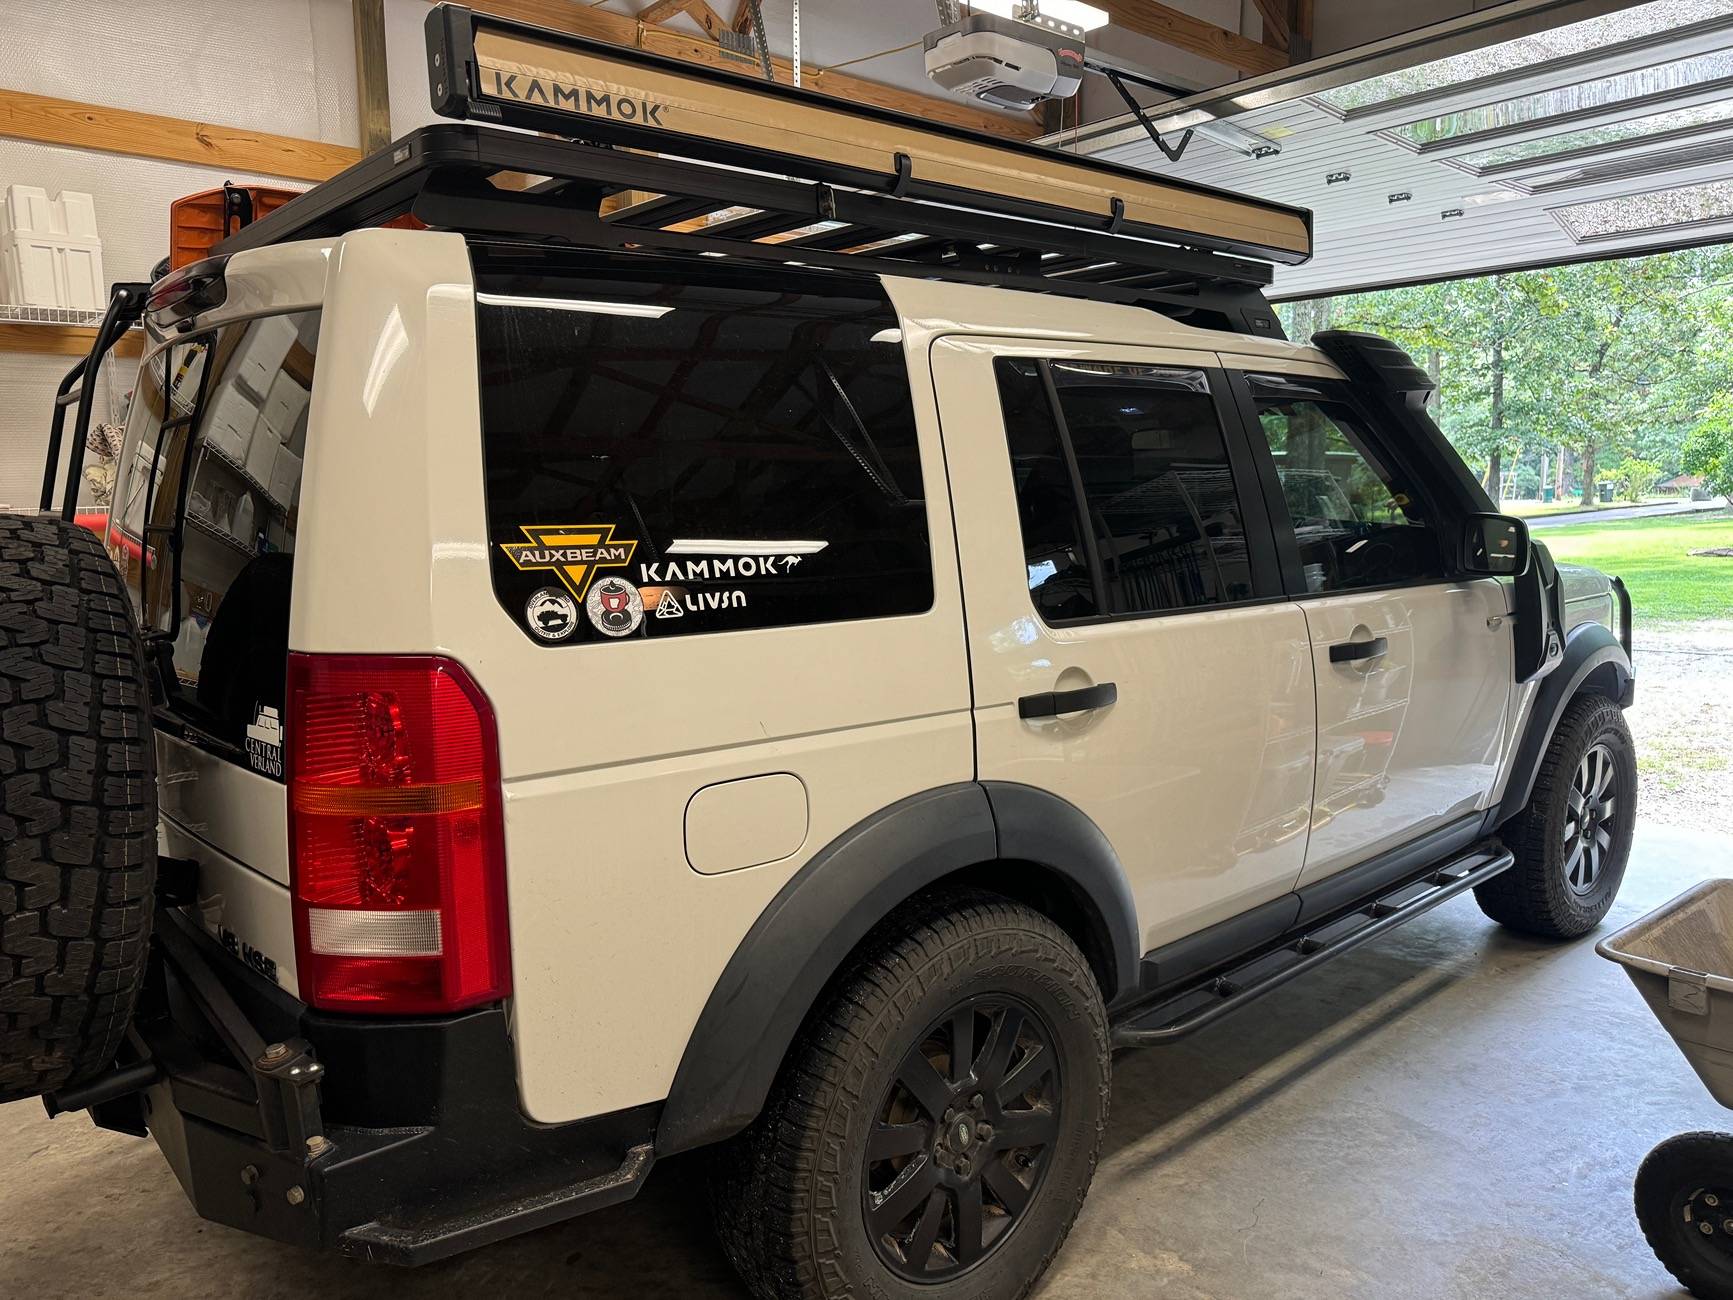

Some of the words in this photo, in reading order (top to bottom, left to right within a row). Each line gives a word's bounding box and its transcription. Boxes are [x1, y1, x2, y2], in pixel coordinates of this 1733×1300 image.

[495, 72, 664, 126] KAMMOK
[519, 548, 626, 563] AUXBEAM
[640, 556, 778, 582] KAMMOK
[245, 737, 282, 763] CENTRAL
